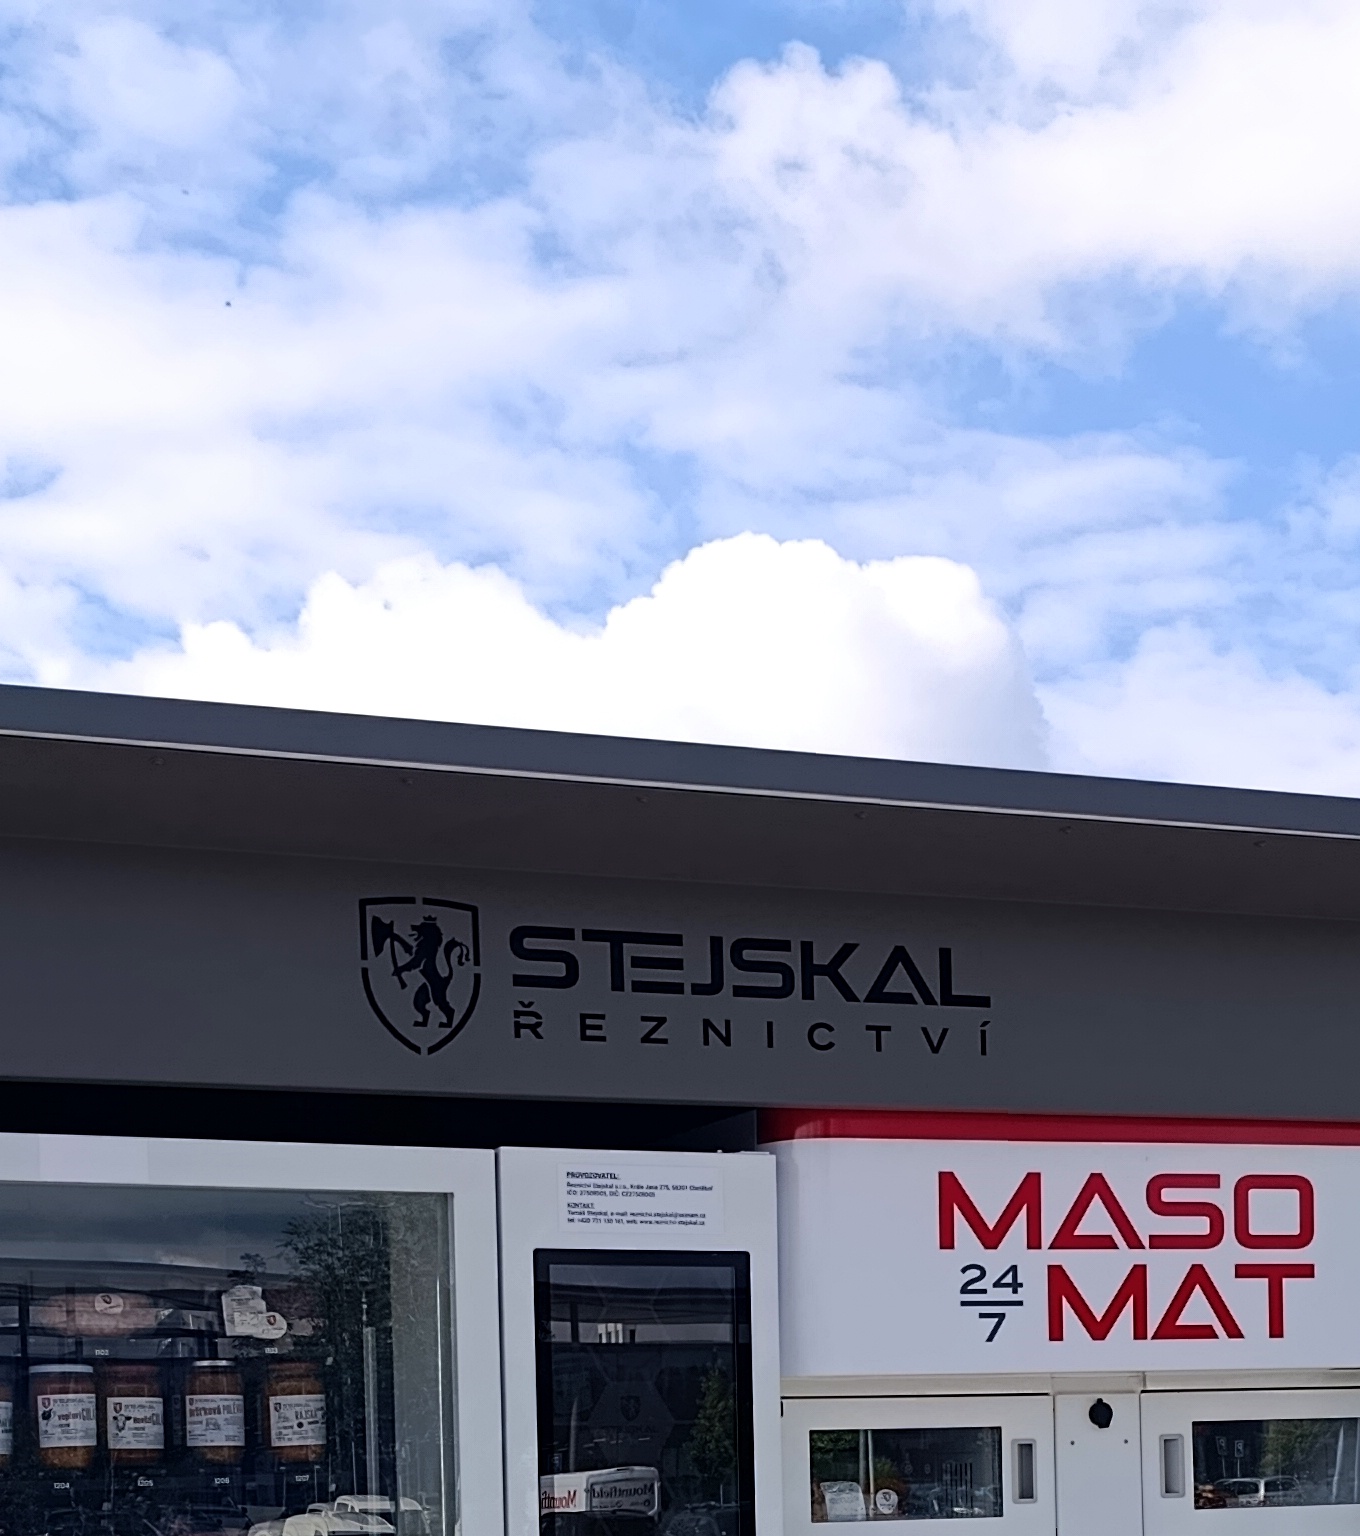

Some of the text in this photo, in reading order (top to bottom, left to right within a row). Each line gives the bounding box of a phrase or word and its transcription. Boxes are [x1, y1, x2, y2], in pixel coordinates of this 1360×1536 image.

[510, 925, 991, 1008] STEJSKAL
[513, 1001, 988, 1056] ŘEZNICTVÍ
[939, 1171, 1315, 1250] MASO
[960, 1263, 1023, 1295] 24
[1047, 1263, 1315, 1341] MAT
[978, 1312, 1006, 1342] 7
